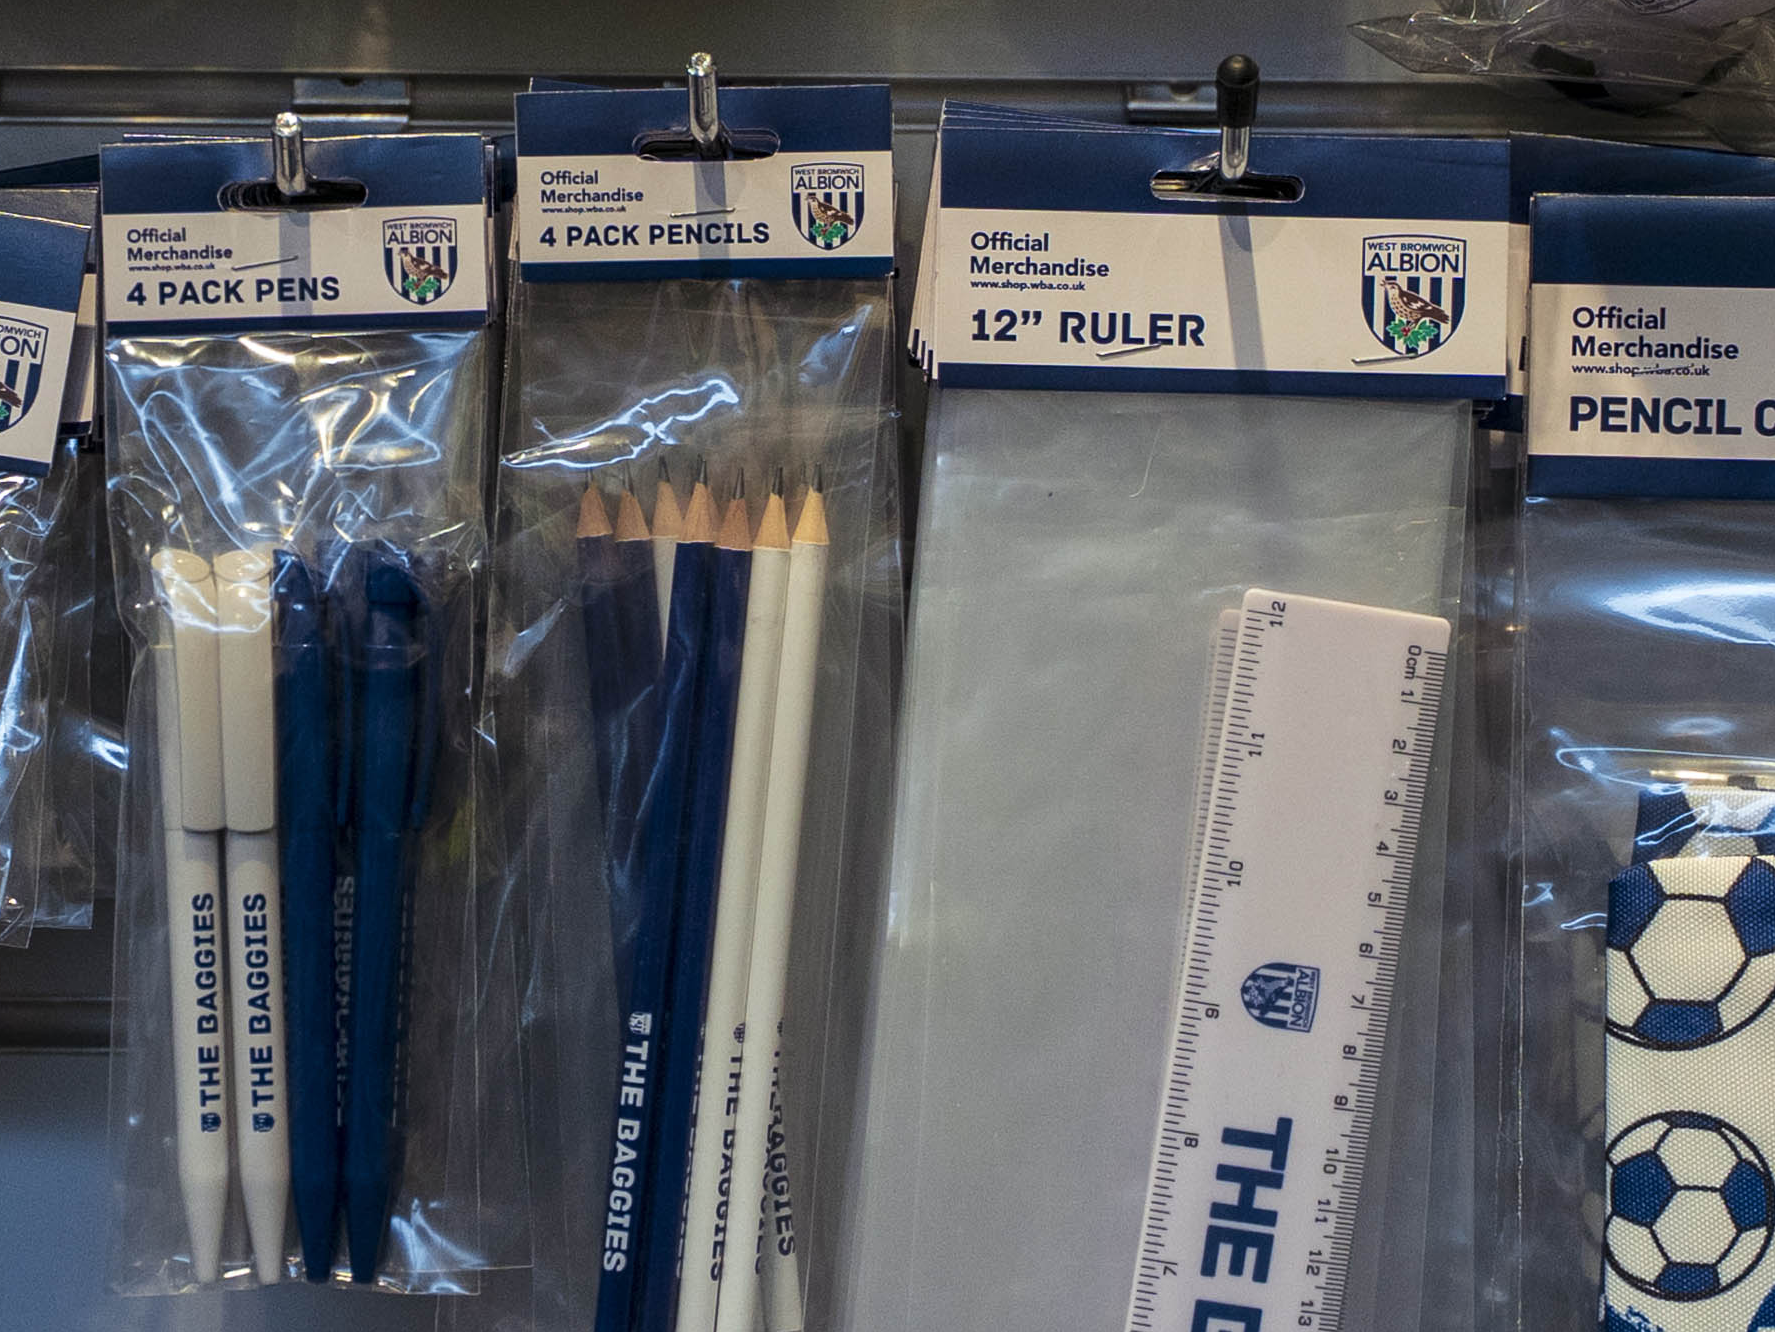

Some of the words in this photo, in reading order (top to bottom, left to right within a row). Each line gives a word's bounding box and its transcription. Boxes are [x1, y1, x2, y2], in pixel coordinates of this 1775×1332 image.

[540, 170, 598, 186] Official
[794, 175, 859, 190] ALBION
[540, 188, 644, 203] Merchandise
[127, 228, 186, 244] Official
[387, 229, 453, 245] ALBION
[540, 226, 556, 246] 4
[567, 225, 639, 246] PACK
[649, 222, 770, 245] PENCILS
[970, 232, 1049, 253] Official
[127, 245, 233, 262] Merchandise
[1367, 241, 1397, 252] WEST
[1400, 242, 1460, 253] BROMWICH
[970, 257, 1110, 278] Merchandise
[1367, 252, 1460, 273] ALBION
[126, 283, 147, 306] 4
[159, 280, 244, 305] PACK
[256, 277, 340, 302] PENS
[970, 279, 1085, 293] www.shop.wba.co.uk
[1059, 311, 1205, 347] RULER
[1572, 306, 1666, 330] Official
[1571, 335, 1739, 360] Merchandise
[1569, 397, 1741, 435] PENCIL
[192, 892, 219, 1034] BAGGIES
[243, 893, 271, 1034] BAGGIES
[1288, 969, 1309, 1027] ALBION
[198, 1045, 221, 1107] THE
[250, 1045, 273, 1107] THE
[620, 1040, 649, 1109] THE
[603, 1117, 642, 1273] BAGGIES
[1200, 1116, 1293, 1283] THE
